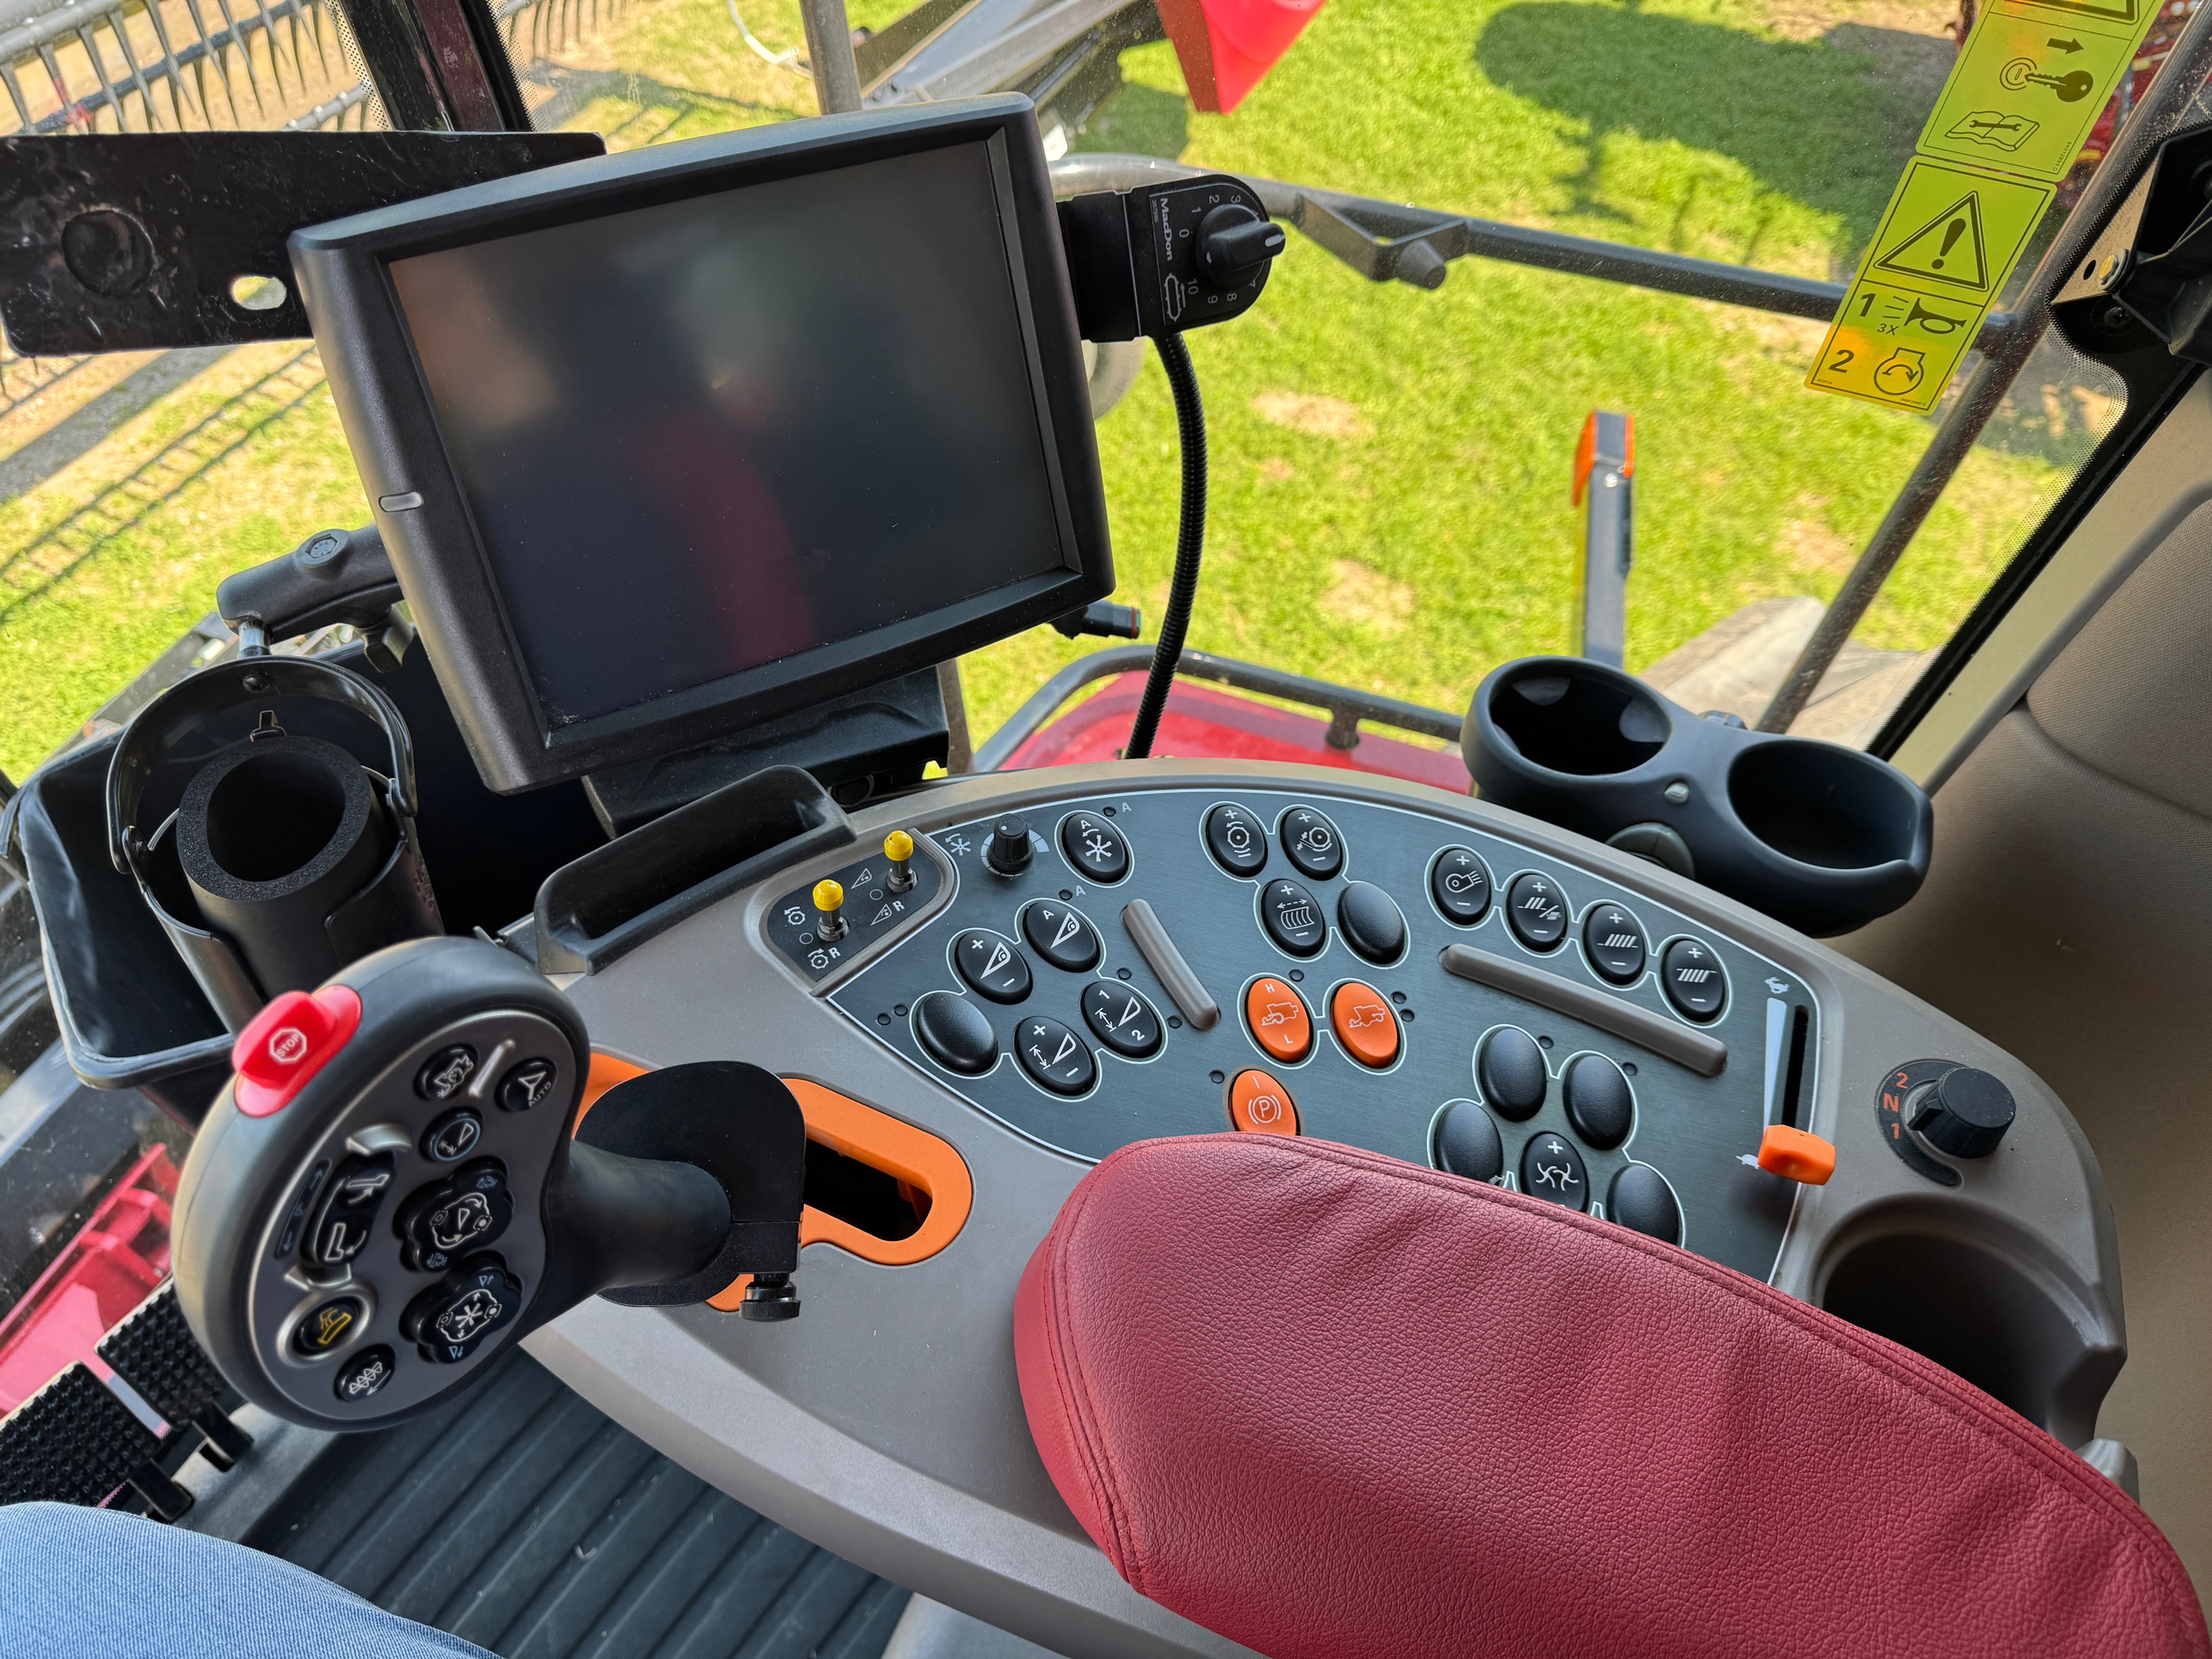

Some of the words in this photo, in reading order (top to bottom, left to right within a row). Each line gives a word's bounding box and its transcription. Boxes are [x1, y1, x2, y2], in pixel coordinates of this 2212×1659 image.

[1209, 194, 1220, 204] 2
[1230, 194, 1241, 204] 3
[1160, 198, 1172, 261] MacDon
[1179, 229, 1189, 237] 0
[1187, 278, 1198, 295] 10
[1207, 295, 1219, 304] 9
[1227, 292, 1237, 301] 8
[1860, 292, 1877, 317] 1
[1877, 322, 1899, 336] 3X
[1828, 349, 1855, 373] 2
[1122, 803, 1133, 812] A
[1080, 820, 1091, 830] A
[1075, 885, 1087, 897] A
[892, 900, 905, 912] R
[1043, 910, 1054, 920] A
[828, 947, 841, 959] R
[1265, 983, 1275, 993] H
[1099, 989, 1109, 1000] 1
[1131, 1029, 1145, 1041] 2
[1283, 1034, 1293, 1044] L
[276, 1033, 299, 1057] STOP
[1896, 1072, 1908, 1089] 2
[528, 1081, 552, 1107] AUTO
[1258, 1100, 1270, 1118] P
[1883, 1094, 1899, 1112] N
[1891, 1123, 1900, 1139] 1
